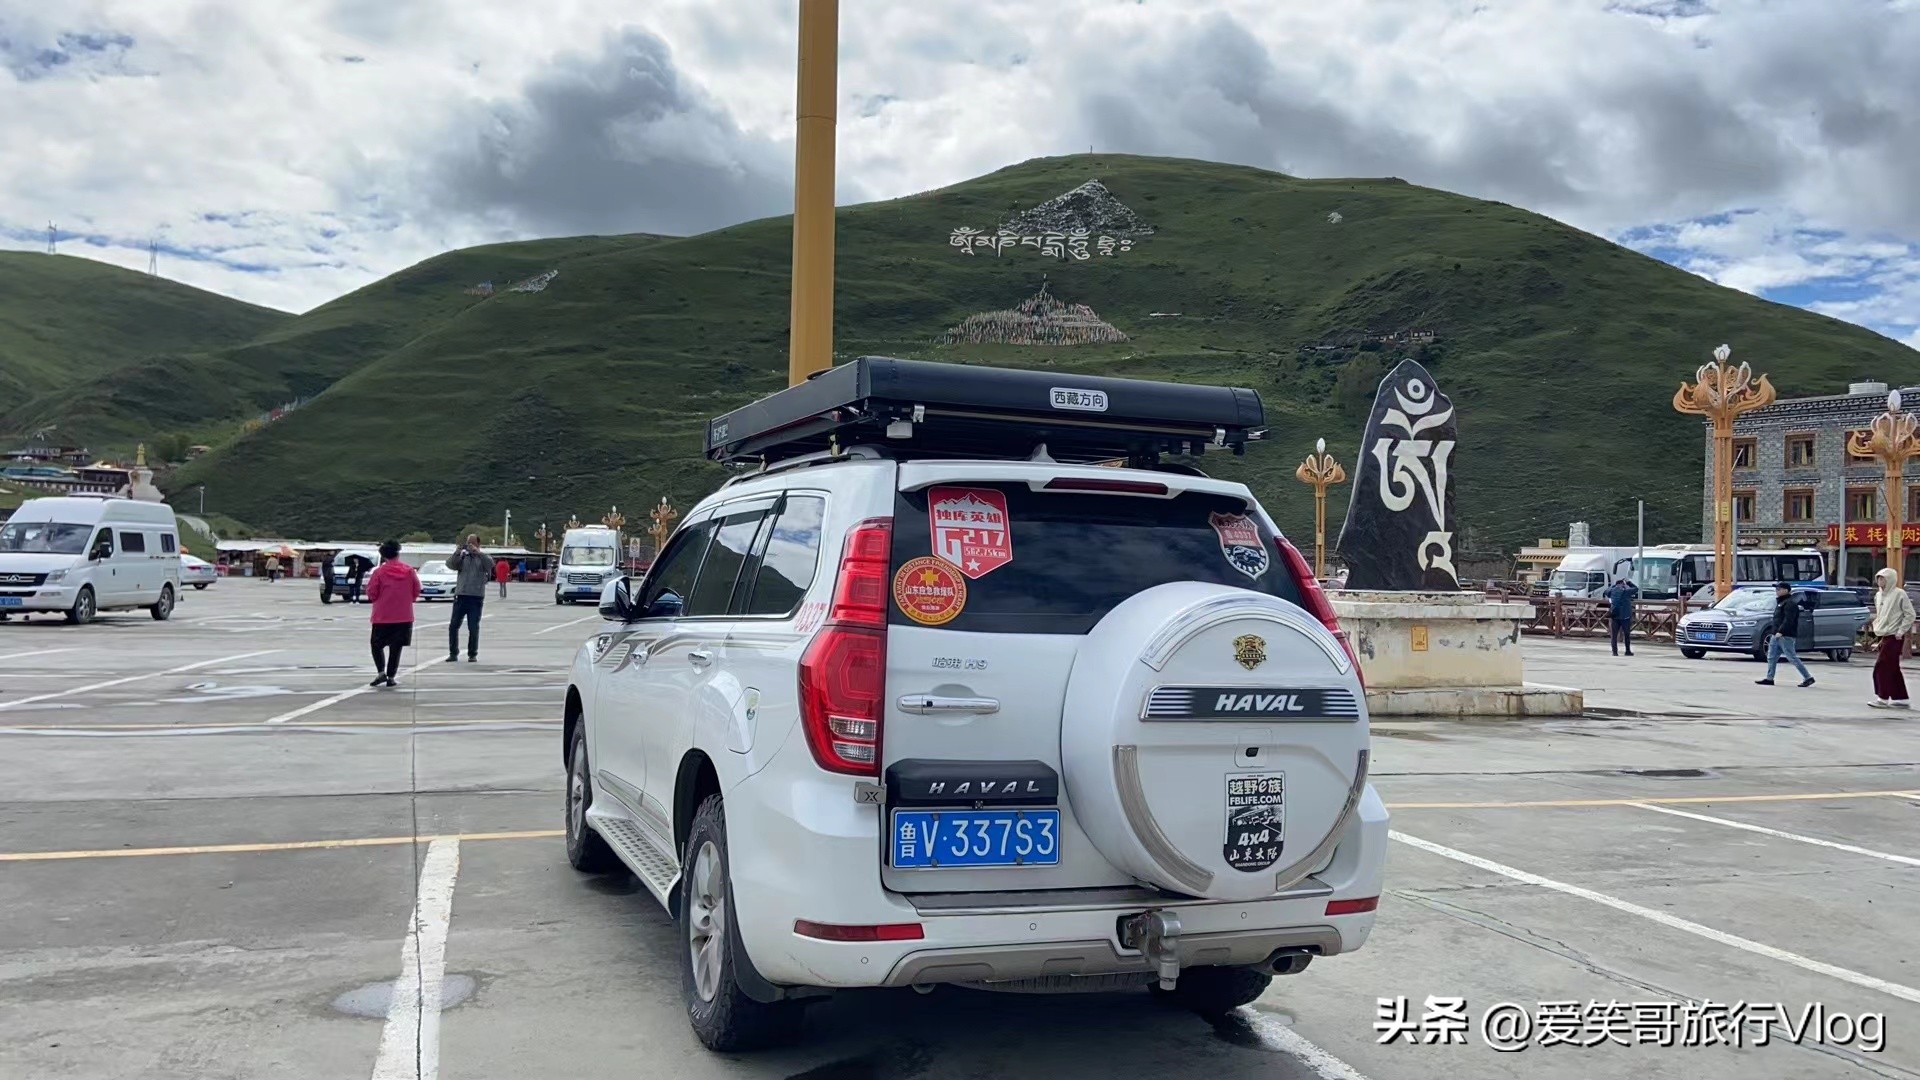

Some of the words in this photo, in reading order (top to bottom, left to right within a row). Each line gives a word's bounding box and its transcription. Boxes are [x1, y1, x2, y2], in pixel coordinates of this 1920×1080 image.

[1053, 390, 1104, 407] 西藏方向
[1214, 694, 1304, 711] HAVAL
[929, 781, 1040, 794] HAVAL
[1229, 779, 1282, 795] 越野e族
[1230, 795, 1281, 805] FBLIFE.COM
